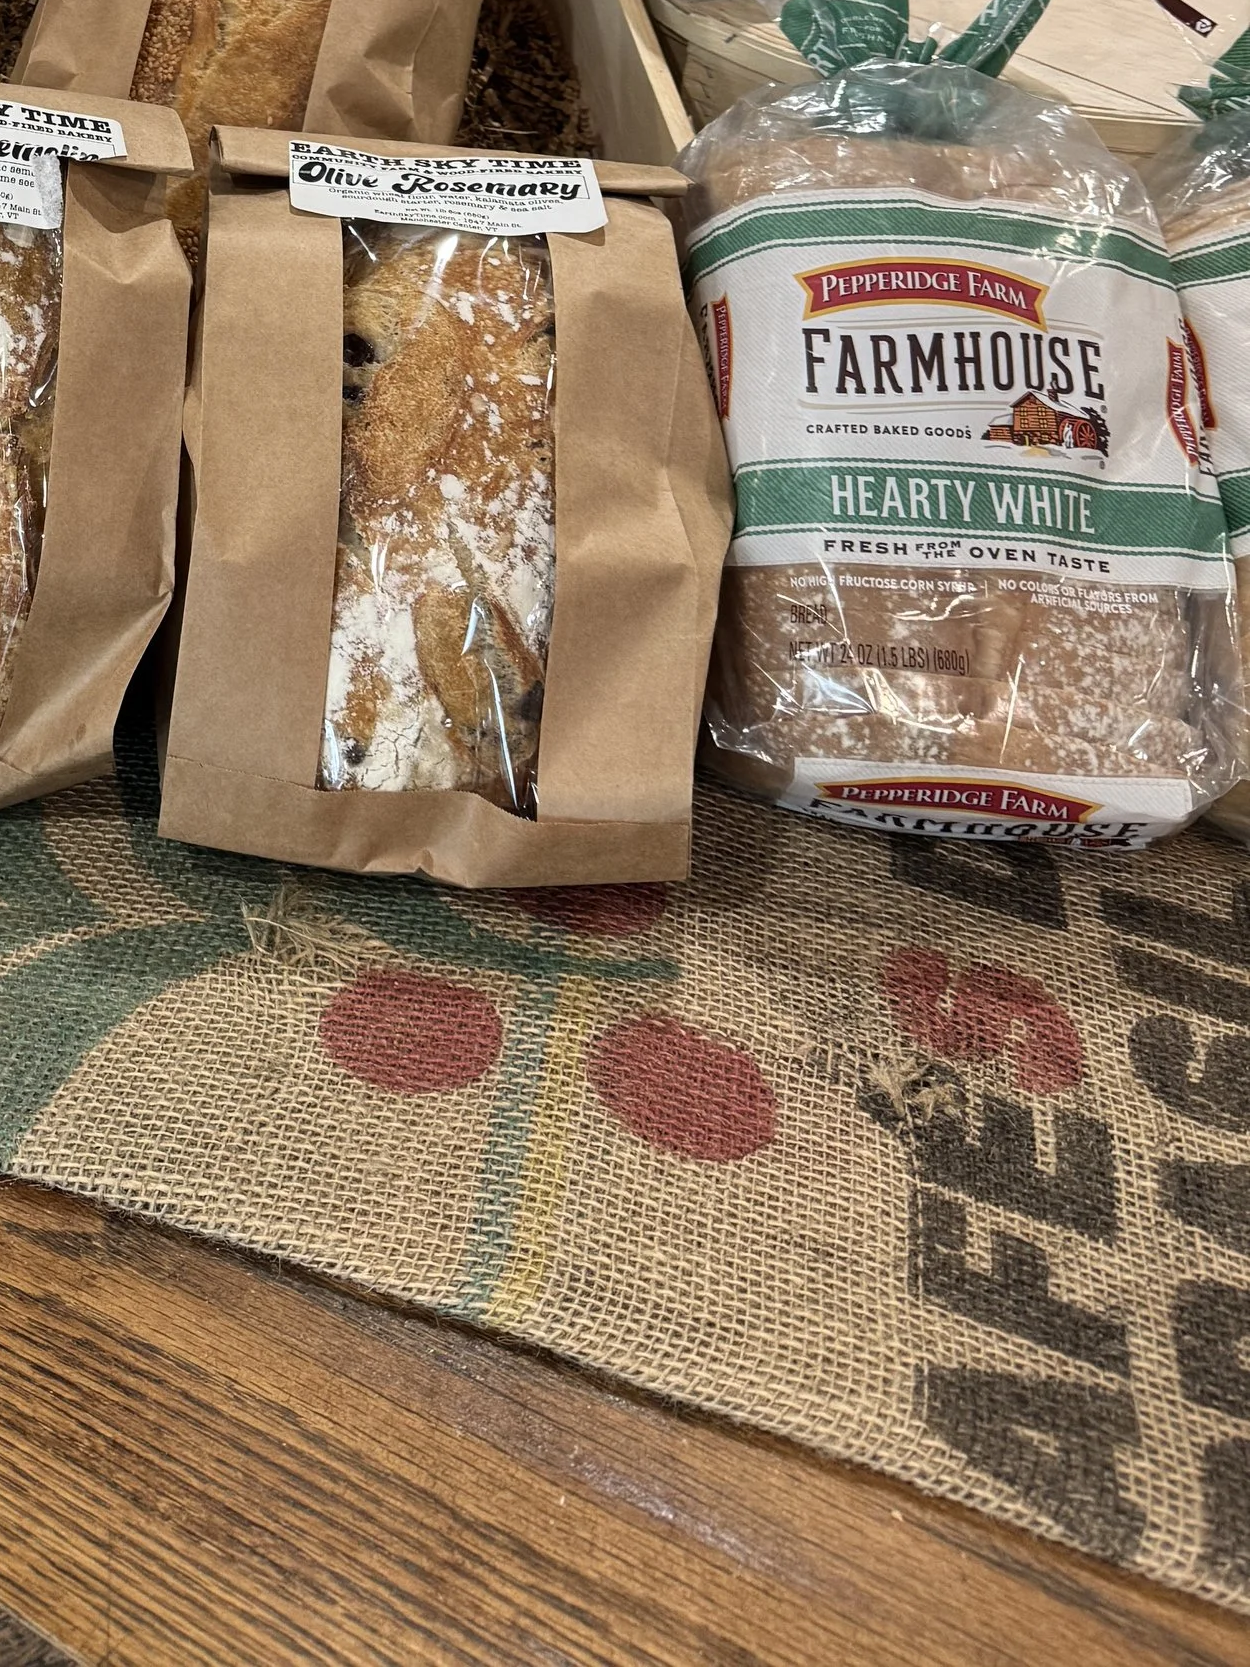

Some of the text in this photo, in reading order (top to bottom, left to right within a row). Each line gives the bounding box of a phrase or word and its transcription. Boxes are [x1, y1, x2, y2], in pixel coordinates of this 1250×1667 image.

[20, 107, 112, 134] TIME
[57, 129, 112, 143] BAKERY
[291, 142, 582, 170] EARTH SKY TIME
[299, 161, 379, 189] Olive
[7, 211, 20, 220] VT
[820, 269, 1028, 311] PEPPERIDGE FARM
[801, 326, 1107, 402] FARMHOUSE
[806, 423, 973, 440] CRAFTED BAKED GOODS
[830, 474, 1096, 535] HEARTY WHITE
[823, 539, 1112, 574] FRESH FROM OVEN TASTE
[921, 548, 956, 559] THE
[790, 576, 807, 587] NO
[839, 575, 899, 590] FRUCTOSE
[900, 578, 936, 591] CORN
[998, 579, 1017, 591] NO
[1060, 584, 1075, 597] OR
[1123, 590, 1159, 604] FROM
[789, 603, 828, 626] BREAD
[1084, 597, 1134, 615] SOURCES
[857, 644, 875, 665] OZ
[876, 644, 899, 668] (1.5
[900, 645, 930, 670] LBS)
[932, 645, 971, 674] (680g)
[841, 786, 1070, 820] PEPPERIDGE FARM
